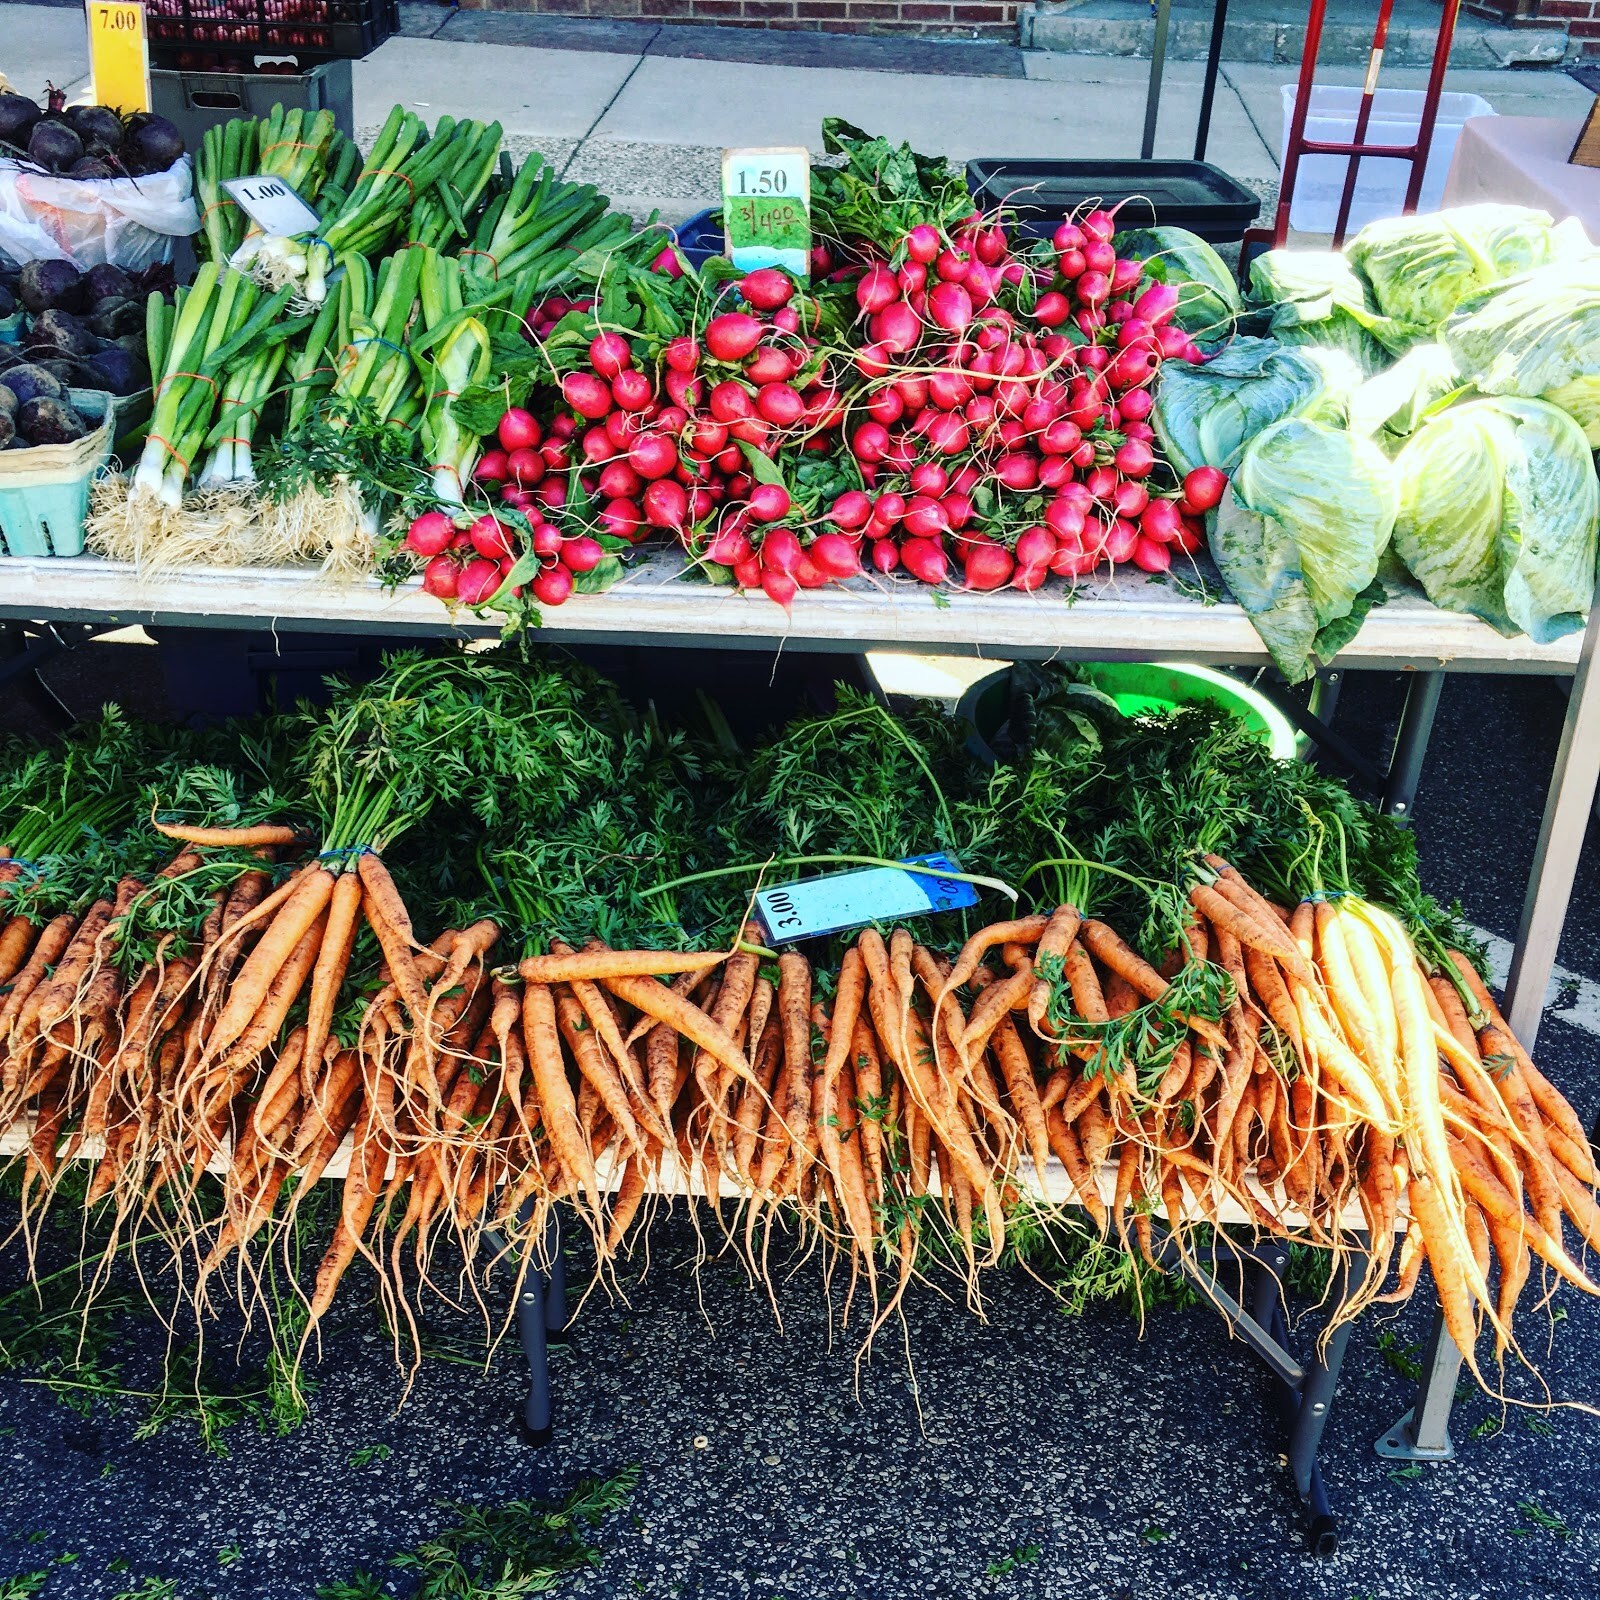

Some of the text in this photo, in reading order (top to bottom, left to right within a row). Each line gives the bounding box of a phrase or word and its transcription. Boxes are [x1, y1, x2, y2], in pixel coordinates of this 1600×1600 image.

[100, 9, 136, 31] 7.00
[241, 183, 286, 201] 1.00
[737, 169, 788, 194] 1.50
[766, 892, 802, 929] 3.00
